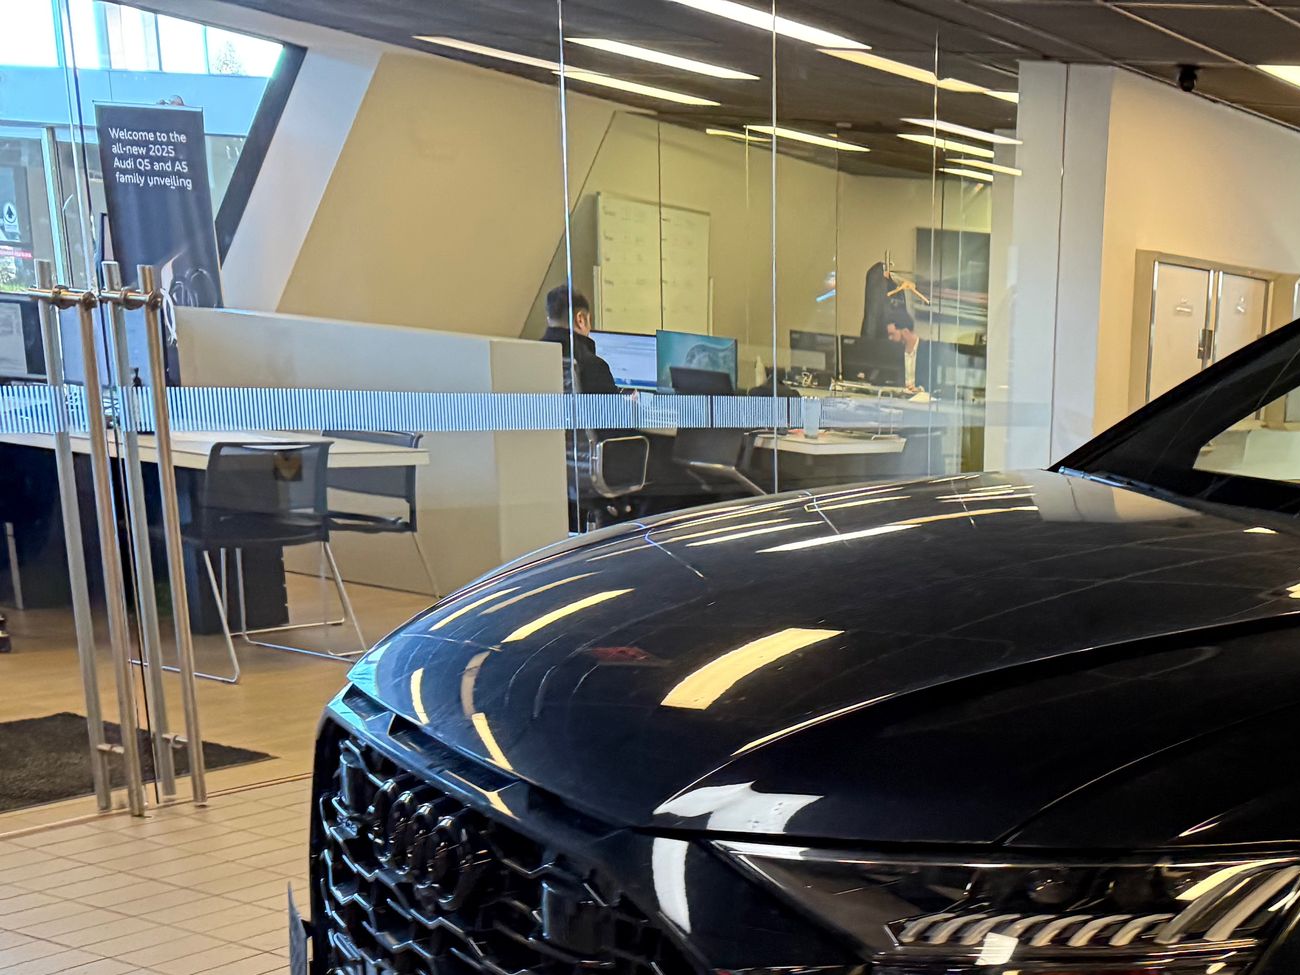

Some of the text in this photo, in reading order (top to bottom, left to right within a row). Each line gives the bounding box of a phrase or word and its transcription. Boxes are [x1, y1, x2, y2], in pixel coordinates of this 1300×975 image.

[108, 127, 187, 143] Welcome to the
[112, 142, 175, 157] all-new 2025
[113, 157, 188, 173] Audi Q5 and A5
[115, 171, 192, 191] family unveiling
